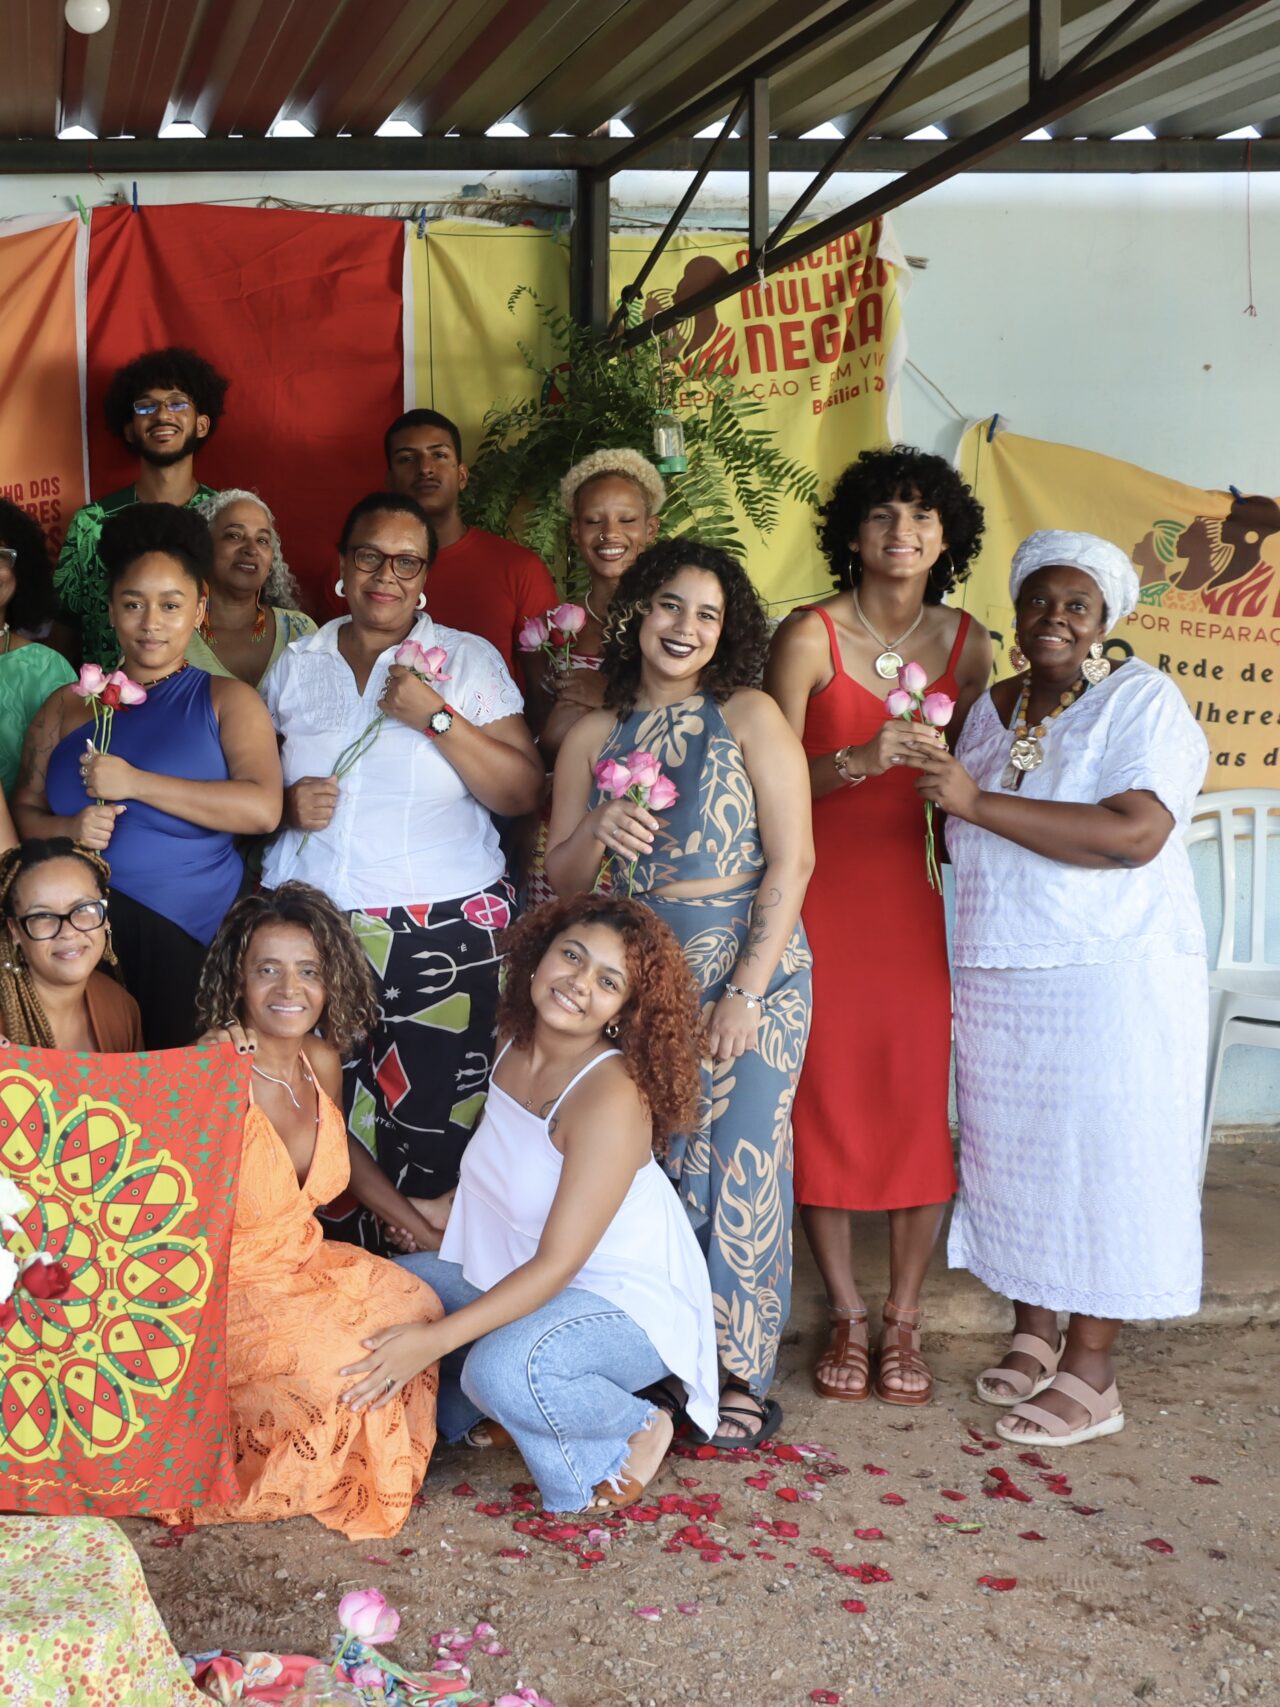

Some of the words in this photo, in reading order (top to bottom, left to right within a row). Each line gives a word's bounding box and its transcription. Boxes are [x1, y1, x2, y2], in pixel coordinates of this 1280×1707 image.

[29, 476, 61, 499] DAS
[1126, 611, 1170, 633] POR
[1158, 653, 1224, 681] Rede
[1241, 663, 1274, 683] de
